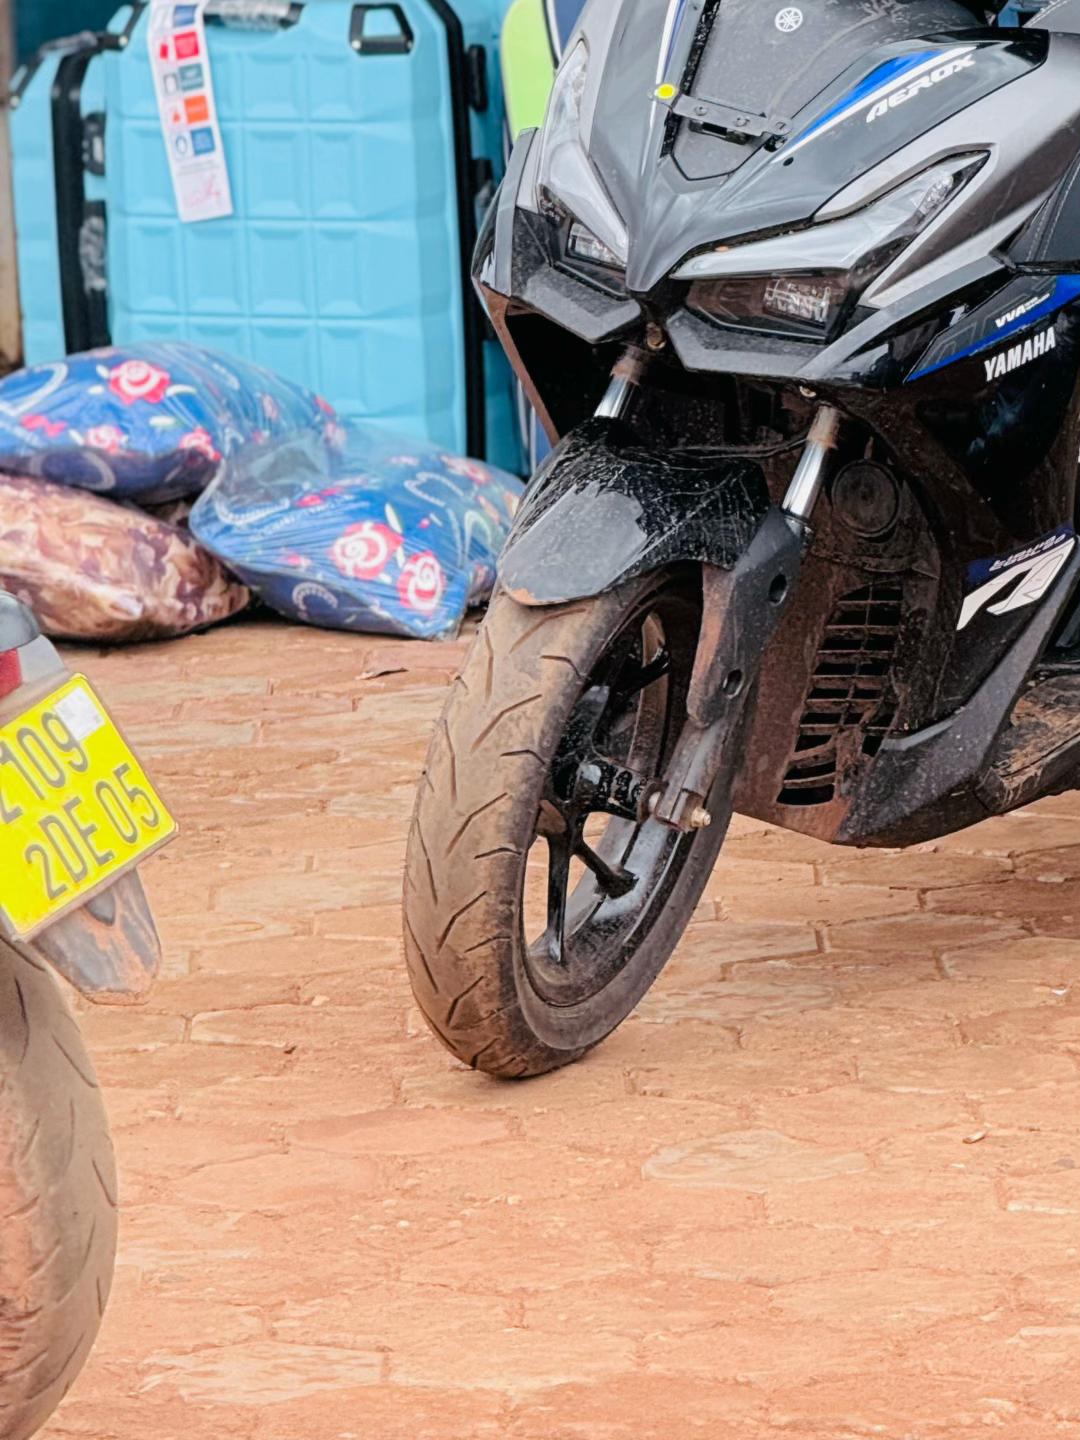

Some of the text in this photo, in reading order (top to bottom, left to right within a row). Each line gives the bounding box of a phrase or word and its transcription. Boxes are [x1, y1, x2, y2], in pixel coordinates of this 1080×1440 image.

[866, 54, 976, 123] AEROX
[995, 303, 1025, 328] VVA
[984, 326, 1056, 383] YAMAHA
[25, 763, 159, 900] 2DE 05
